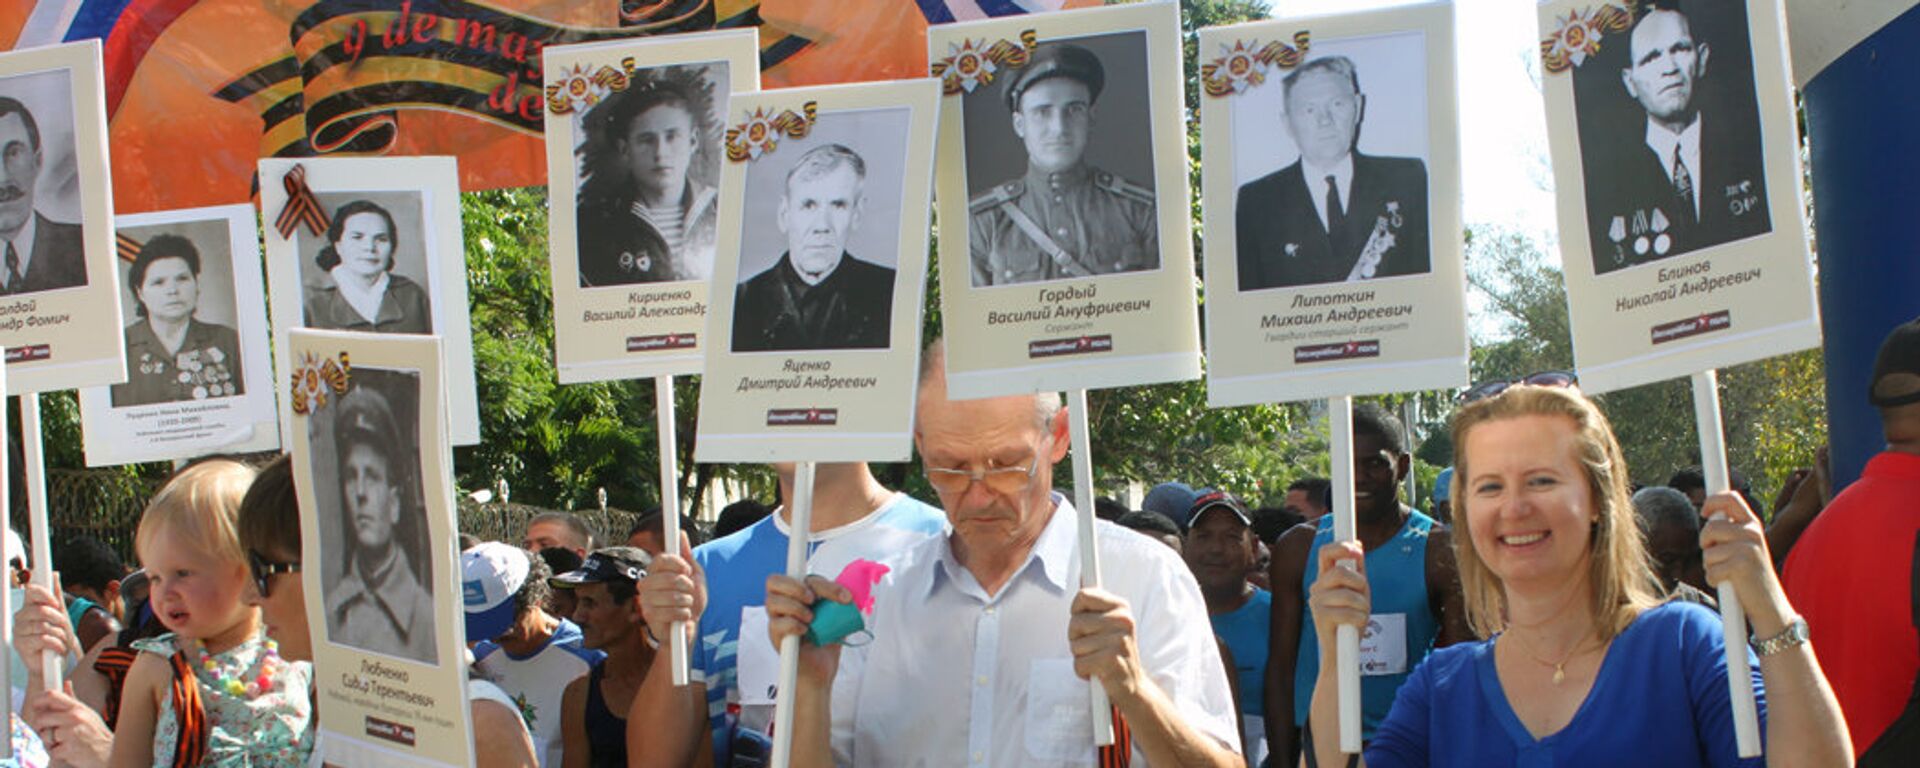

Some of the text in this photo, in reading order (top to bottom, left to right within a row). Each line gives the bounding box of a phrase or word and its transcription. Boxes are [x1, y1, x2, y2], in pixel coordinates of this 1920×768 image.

[382, 0, 438, 49] de
[453, 17, 544, 79] may
[488, 71, 544, 121] de
[1657, 260, 1711, 283] Блинов
[627, 290, 692, 305] Кириенко
[1038, 283, 1097, 304] Гордый
[1290, 290, 1376, 309] Липоткин
[1615, 267, 1762, 312] Николай Андреевич
[582, 302, 707, 322] Василий Александр
[987, 299, 1152, 325] Василий Ануфриевич
[1260, 304, 1413, 329] Михаил Андреевич
[782, 358, 832, 373] Яценко
[736, 375, 878, 392] Дмитрий Андреевич
